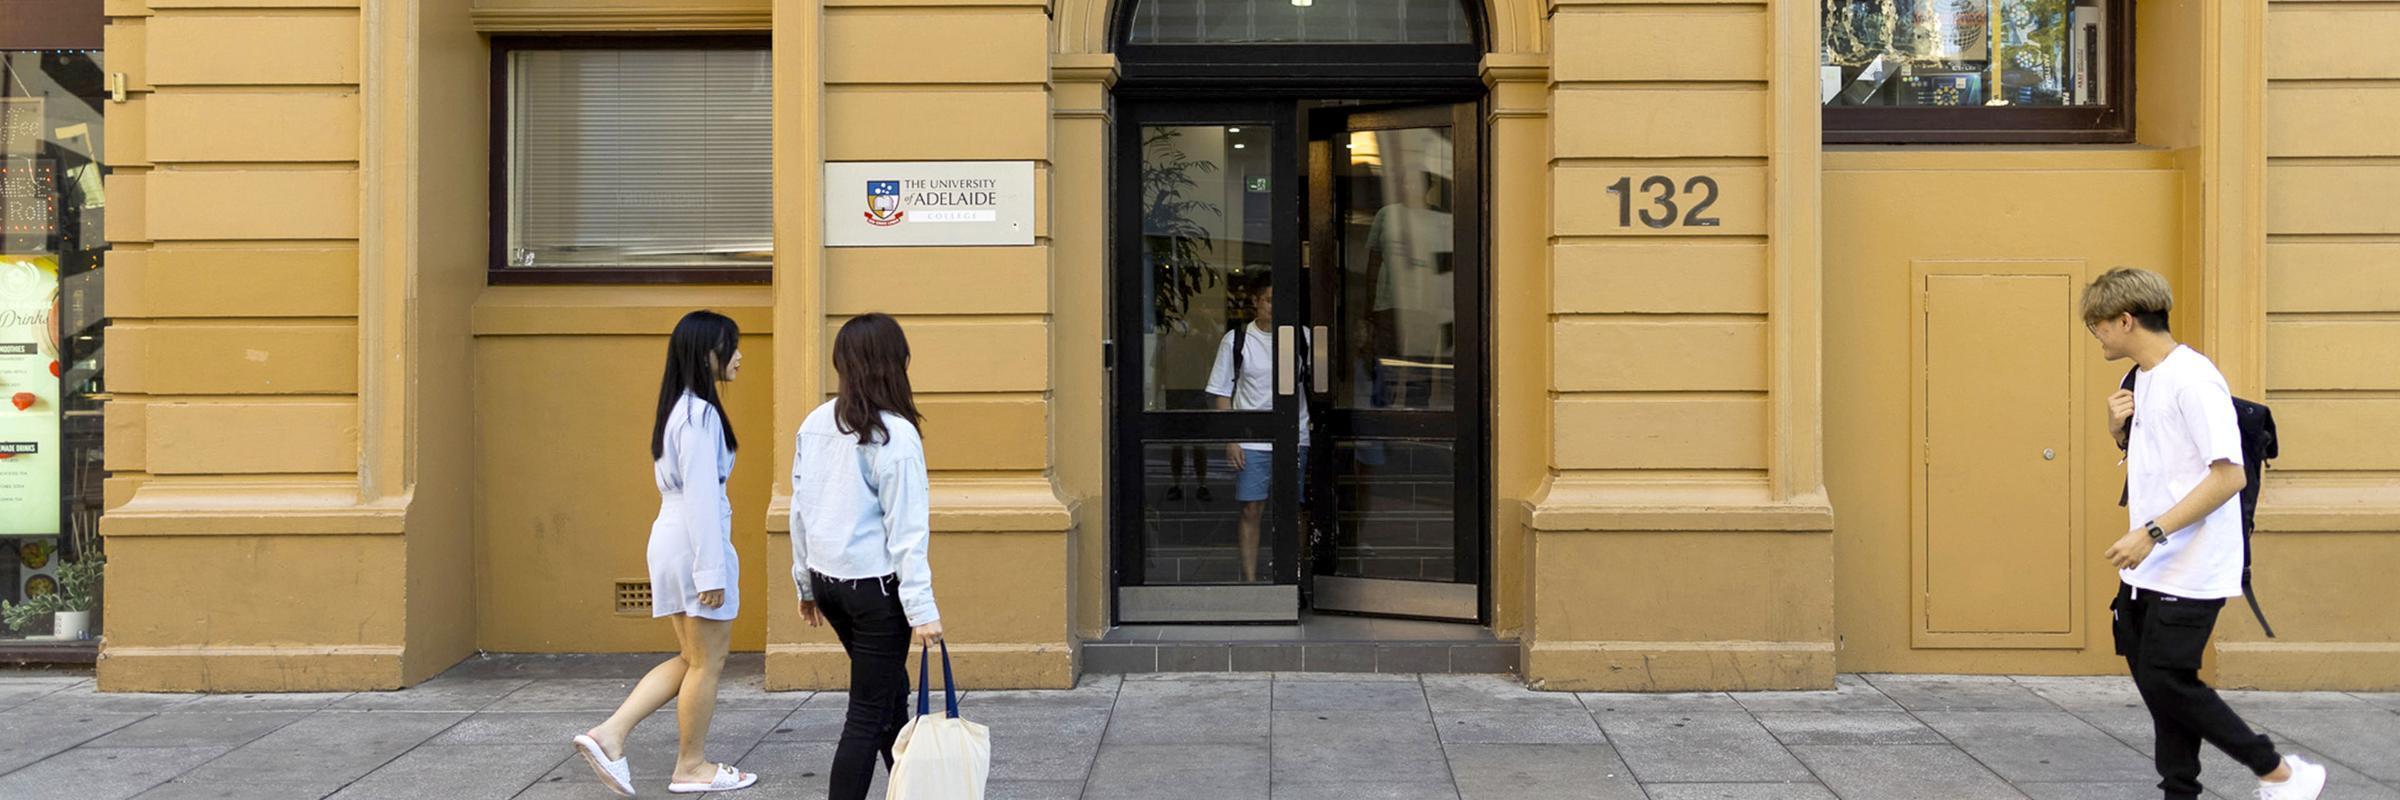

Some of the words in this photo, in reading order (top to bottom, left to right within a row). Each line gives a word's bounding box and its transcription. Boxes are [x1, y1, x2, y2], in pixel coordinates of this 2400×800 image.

[904, 179, 926, 189] THE
[930, 179, 996, 189] UNIVERSITY
[904, 192, 915, 206] of
[914, 191, 997, 206] ADELAIDE
[1606, 175, 1720, 228] 132
[10, 200, 47, 220] Roll
[0, 309, 49, 328] Drinks
